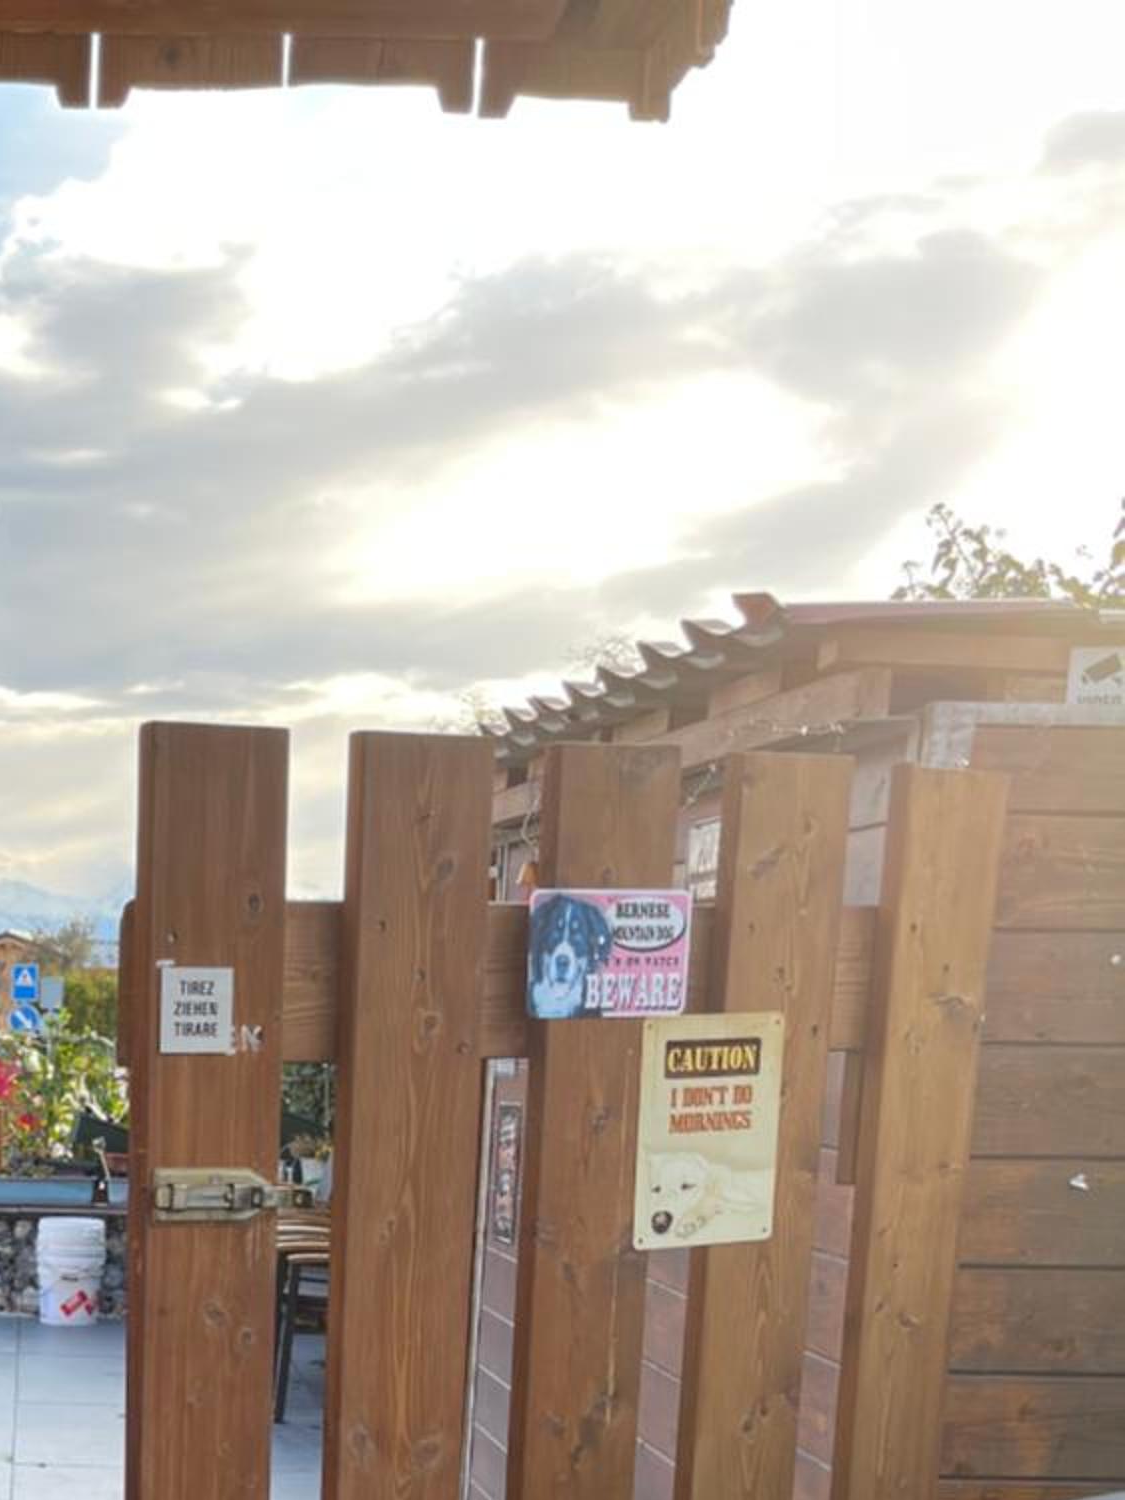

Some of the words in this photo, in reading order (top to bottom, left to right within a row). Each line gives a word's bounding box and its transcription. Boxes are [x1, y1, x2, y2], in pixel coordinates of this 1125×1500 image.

[179, 980, 215, 996] TIREZ
[585, 972, 682, 1010] BEWARE
[173, 1001, 218, 1018] ZIEHEN
[174, 1021, 218, 1038] TIRARE
[667, 1045, 757, 1073] CAUTION
[670, 1087, 677, 1108] I
[668, 1110, 753, 1133] MORNINGS
